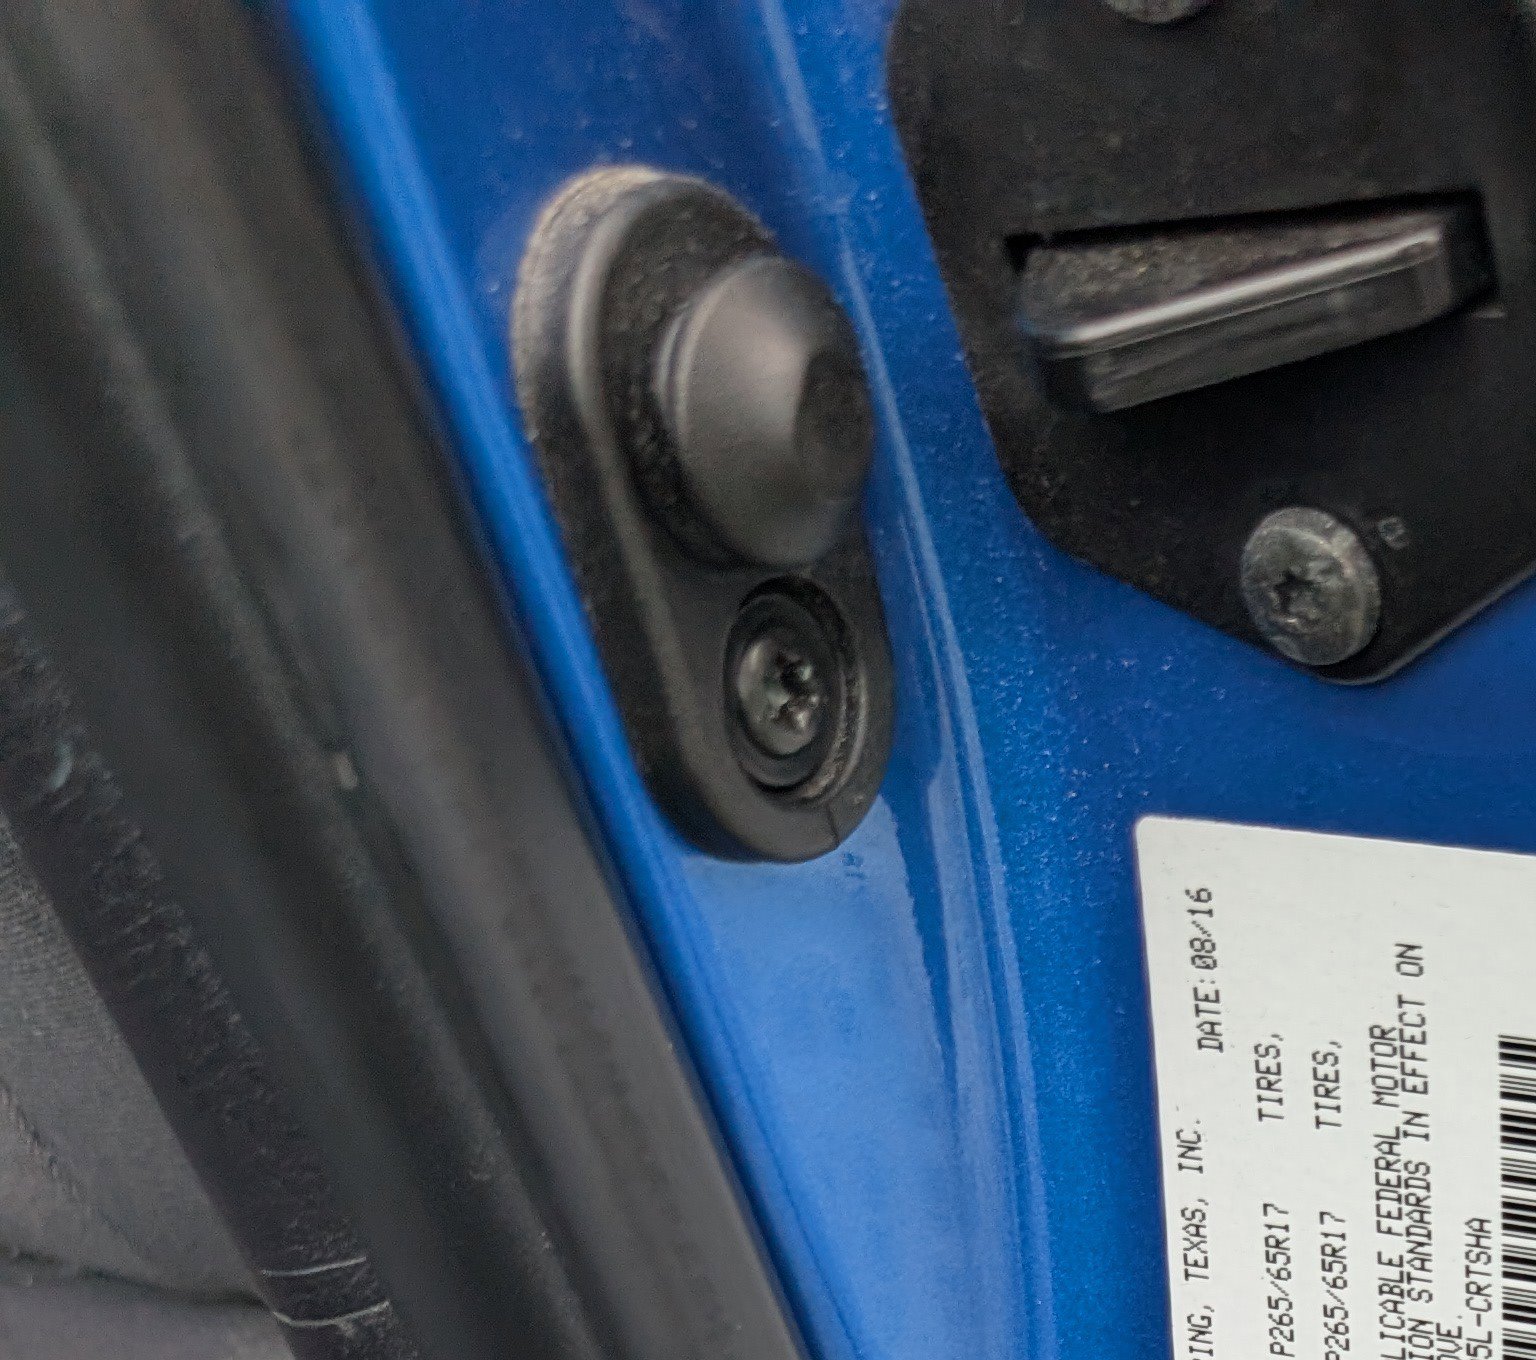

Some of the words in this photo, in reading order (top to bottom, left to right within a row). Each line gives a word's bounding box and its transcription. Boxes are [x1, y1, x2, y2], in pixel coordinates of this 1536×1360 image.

[1395, 943, 1424, 978] ON
[1253, 1034, 1285, 1122] TIRES,
[1311, 1041, 1342, 1130] TIRES,
[1368, 1024, 1400, 1108] MOTOR
[1397, 994, 1429, 1096] EFFECT
[1175, 1120, 1204, 1175] INC.
[1402, 1110, 1430, 1142] IN
[1372, 1125, 1404, 1237] FEDERAL
[1180, 1198, 1210, 1282] TEXAS,
[1403, 1160, 1433, 1304] STANDARDS
[1262, 1202, 1296, 1358] P265/65R17
